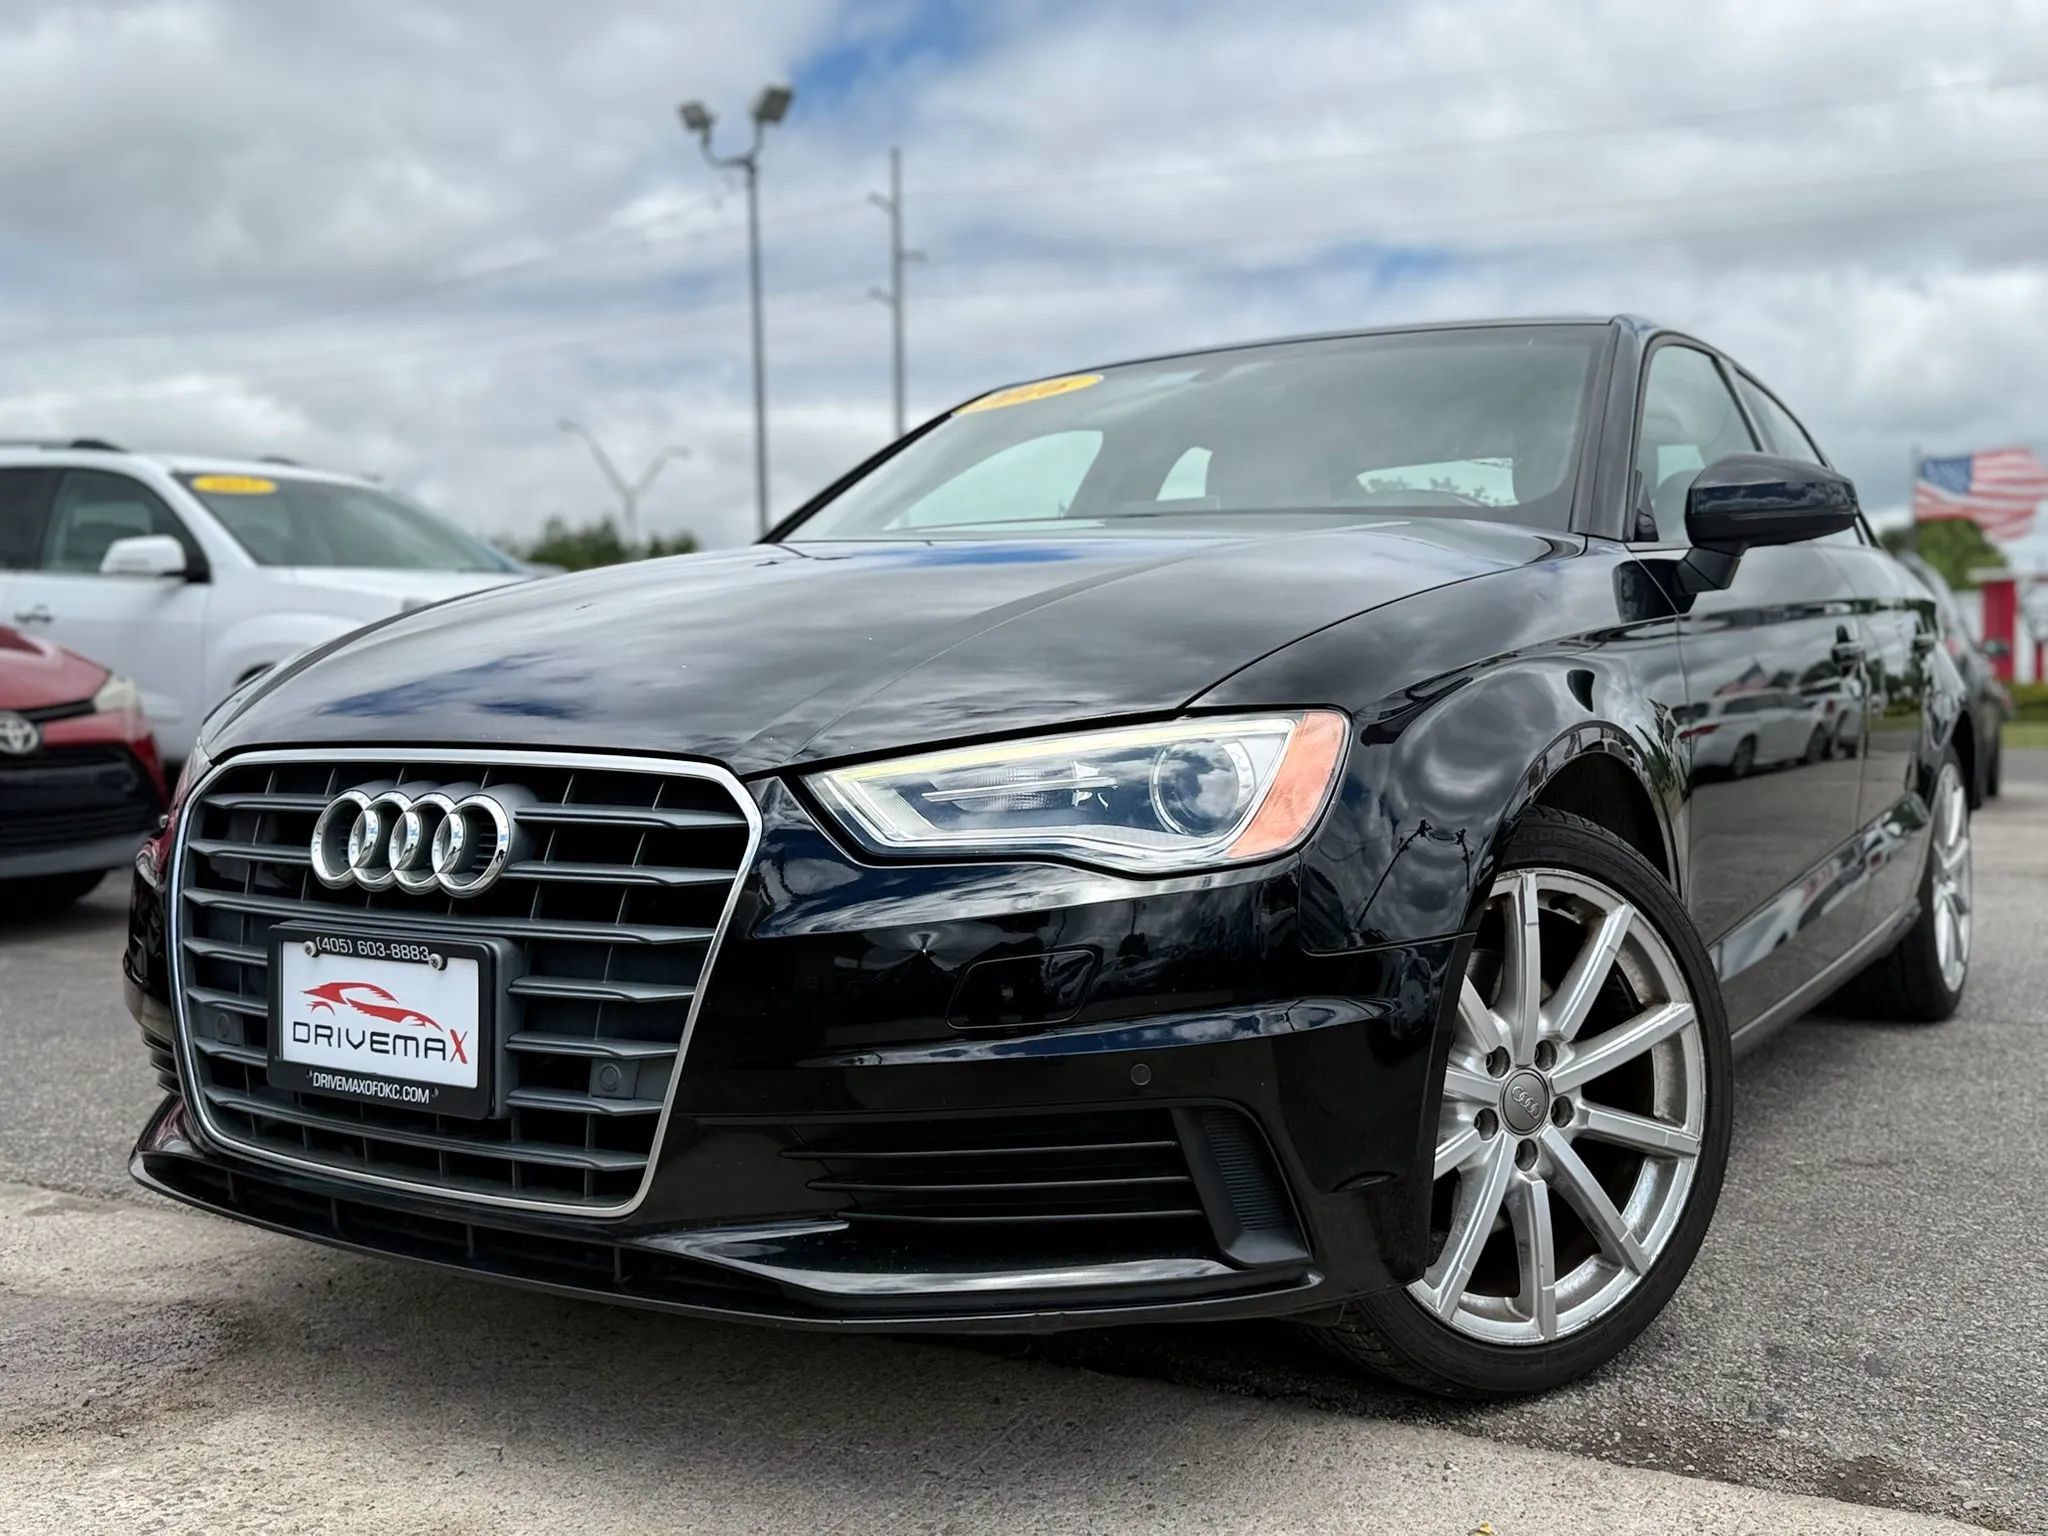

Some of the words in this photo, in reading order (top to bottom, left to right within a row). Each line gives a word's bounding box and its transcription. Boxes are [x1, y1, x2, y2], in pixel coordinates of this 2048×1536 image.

[316, 936, 353, 954] (405)
[357, 940, 430, 961] 603-8883
[293, 1021, 468, 1064] DRIVEMAX
[313, 1071, 430, 1103] DRIVEMAXOFOKC.COM
